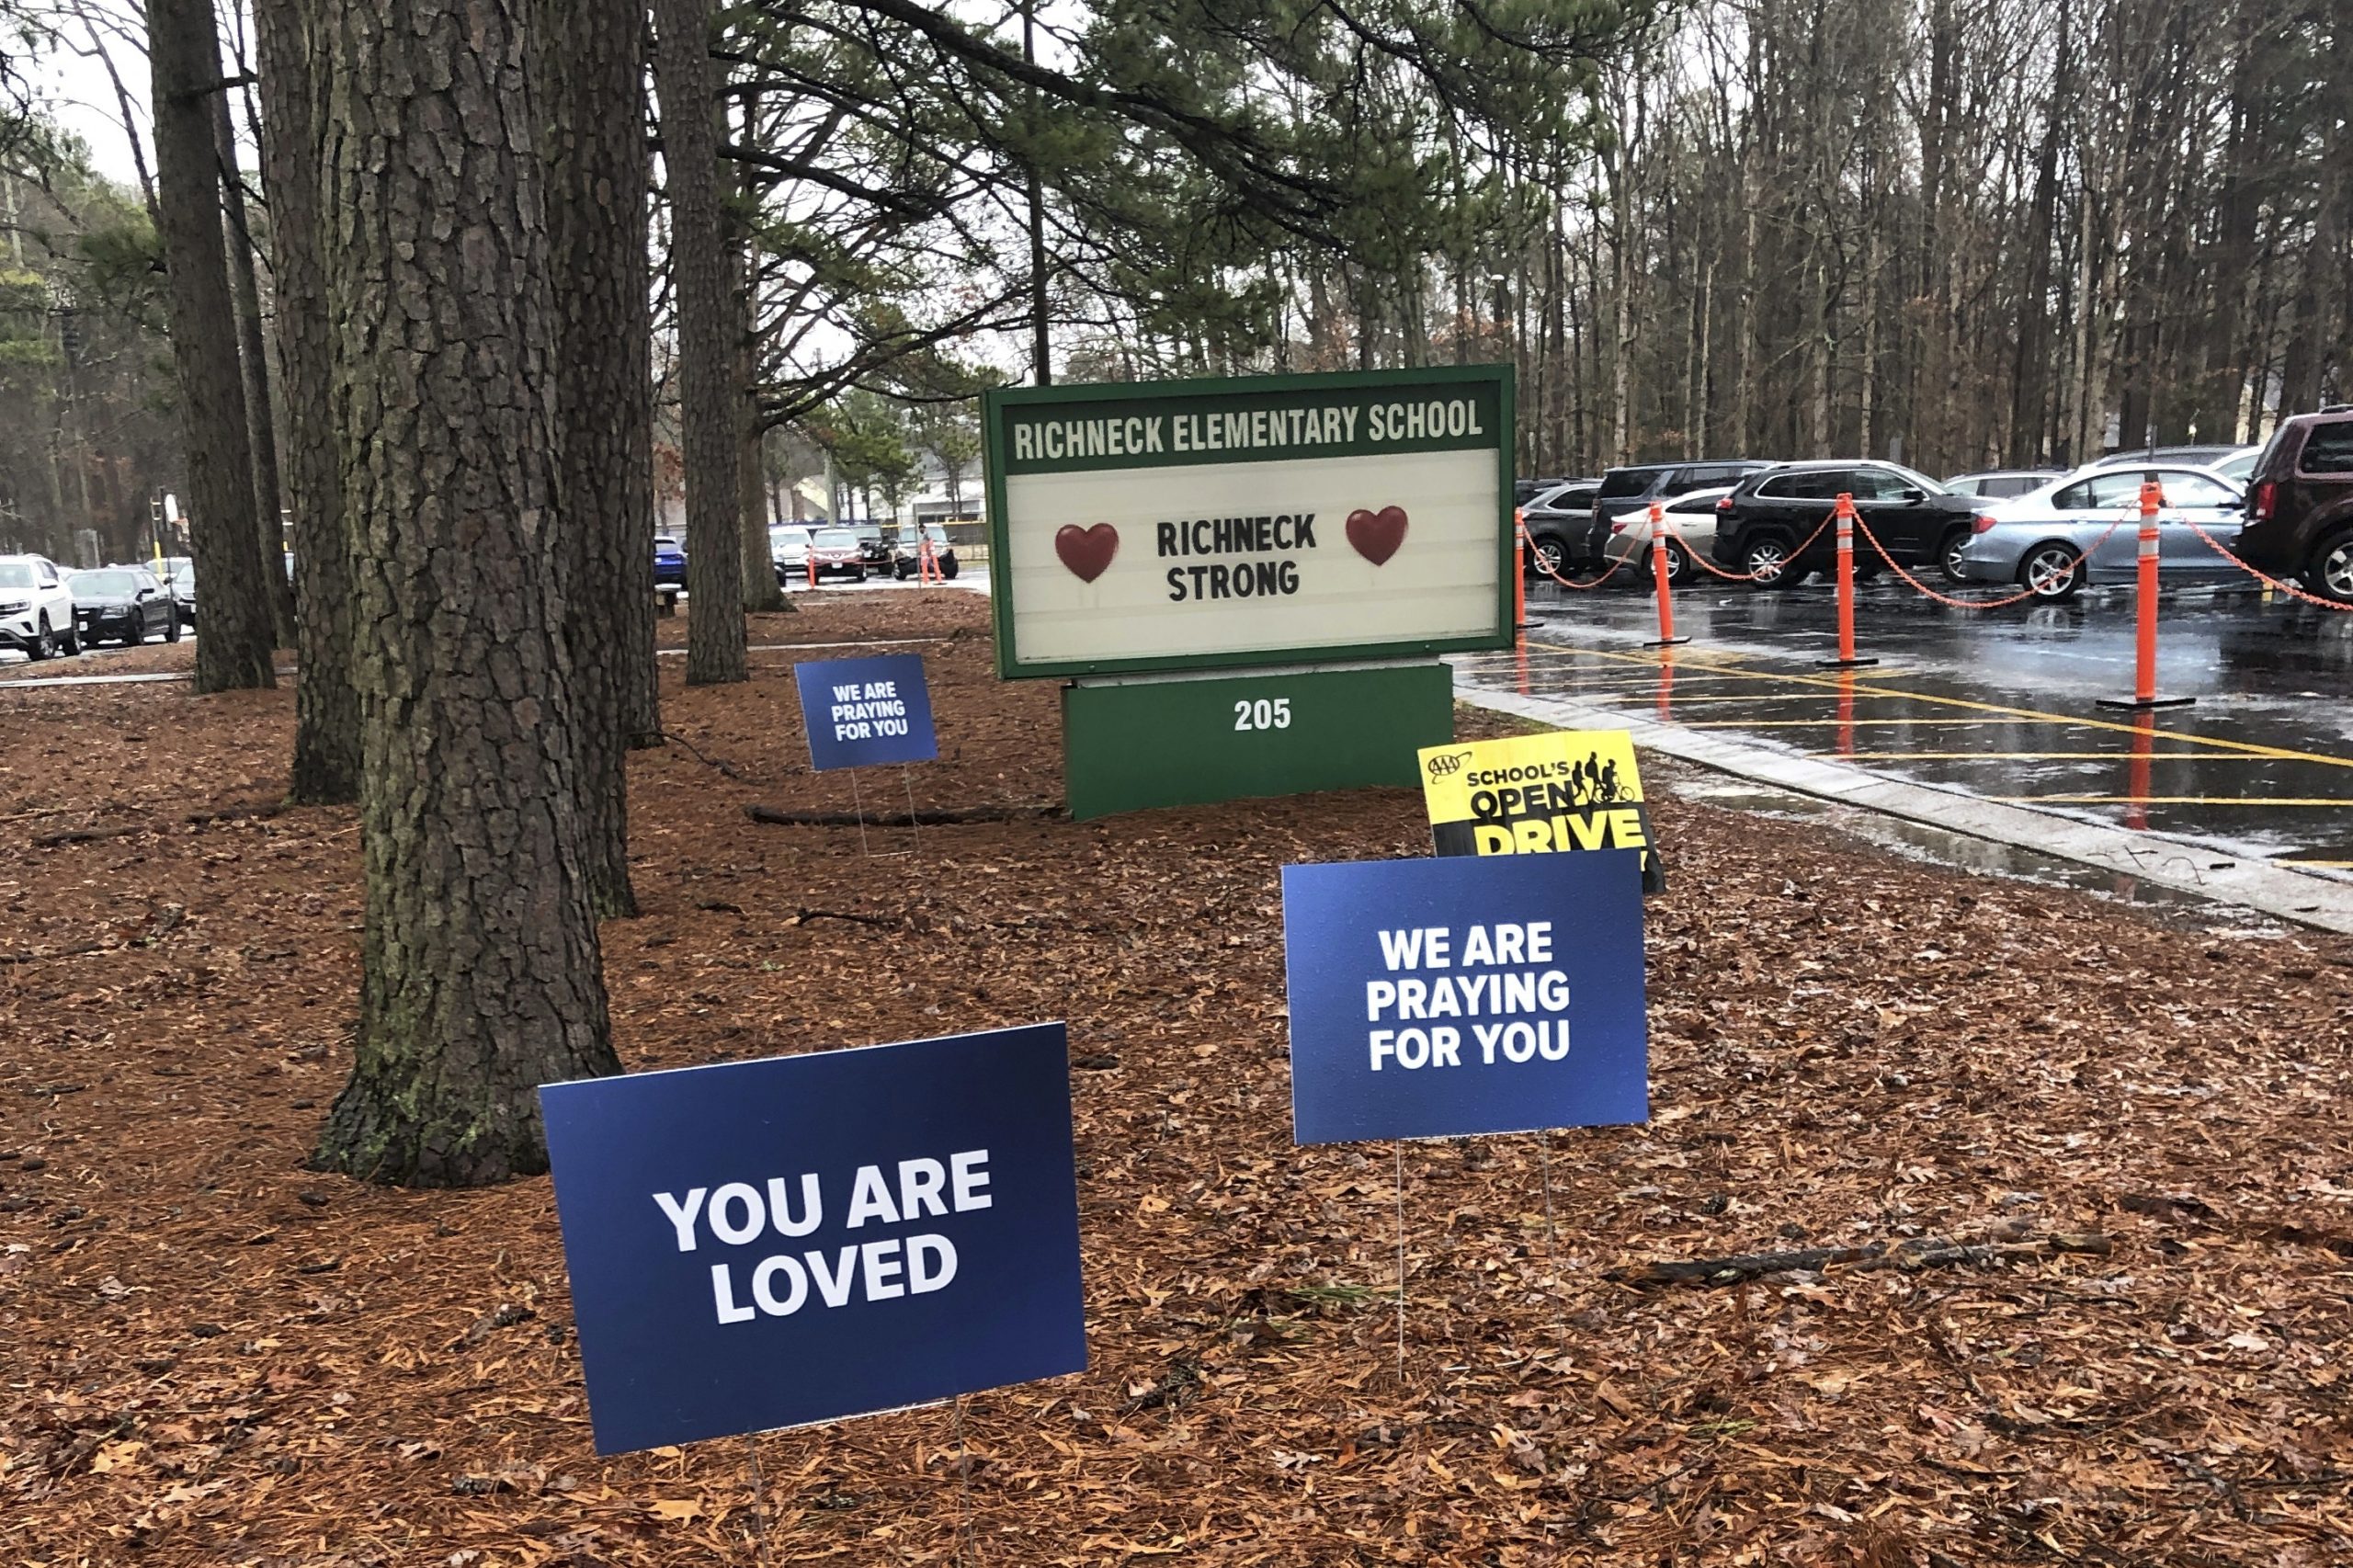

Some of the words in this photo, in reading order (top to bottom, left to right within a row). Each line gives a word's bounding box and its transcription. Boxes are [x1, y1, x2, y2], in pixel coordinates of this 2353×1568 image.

[1015, 416, 1164, 460] RICHNECK
[1173, 406, 1358, 451] ELEMENTARY
[1368, 399, 1483, 442] SCHOOL
[1157, 514, 1317, 557] RICHNECK
[1166, 562, 1300, 601] STRONG
[831, 700, 905, 722] PRAYING
[833, 685, 861, 702] WE
[864, 681, 896, 700] ARE
[835, 722, 871, 741] FOR
[872, 719, 908, 736] YOU
[1234, 698, 1291, 731] 205
[1431, 755, 1459, 773] AAA
[1467, 761, 1570, 787] SCHOOL'S
[1471, 780, 1576, 818] OPEN
[1473, 808, 1647, 857] DRIVE
[1378, 927, 1450, 971] WE
[1462, 922, 1552, 967] ARE
[1366, 971, 1570, 1022] PRAYING
[1370, 1027, 1461, 1071] FOR
[1472, 1019, 1570, 1064] YOU
[653, 1173, 824, 1252] YOU
[847, 1149, 993, 1229] ARE
[711, 1233, 958, 1324] LOVED
